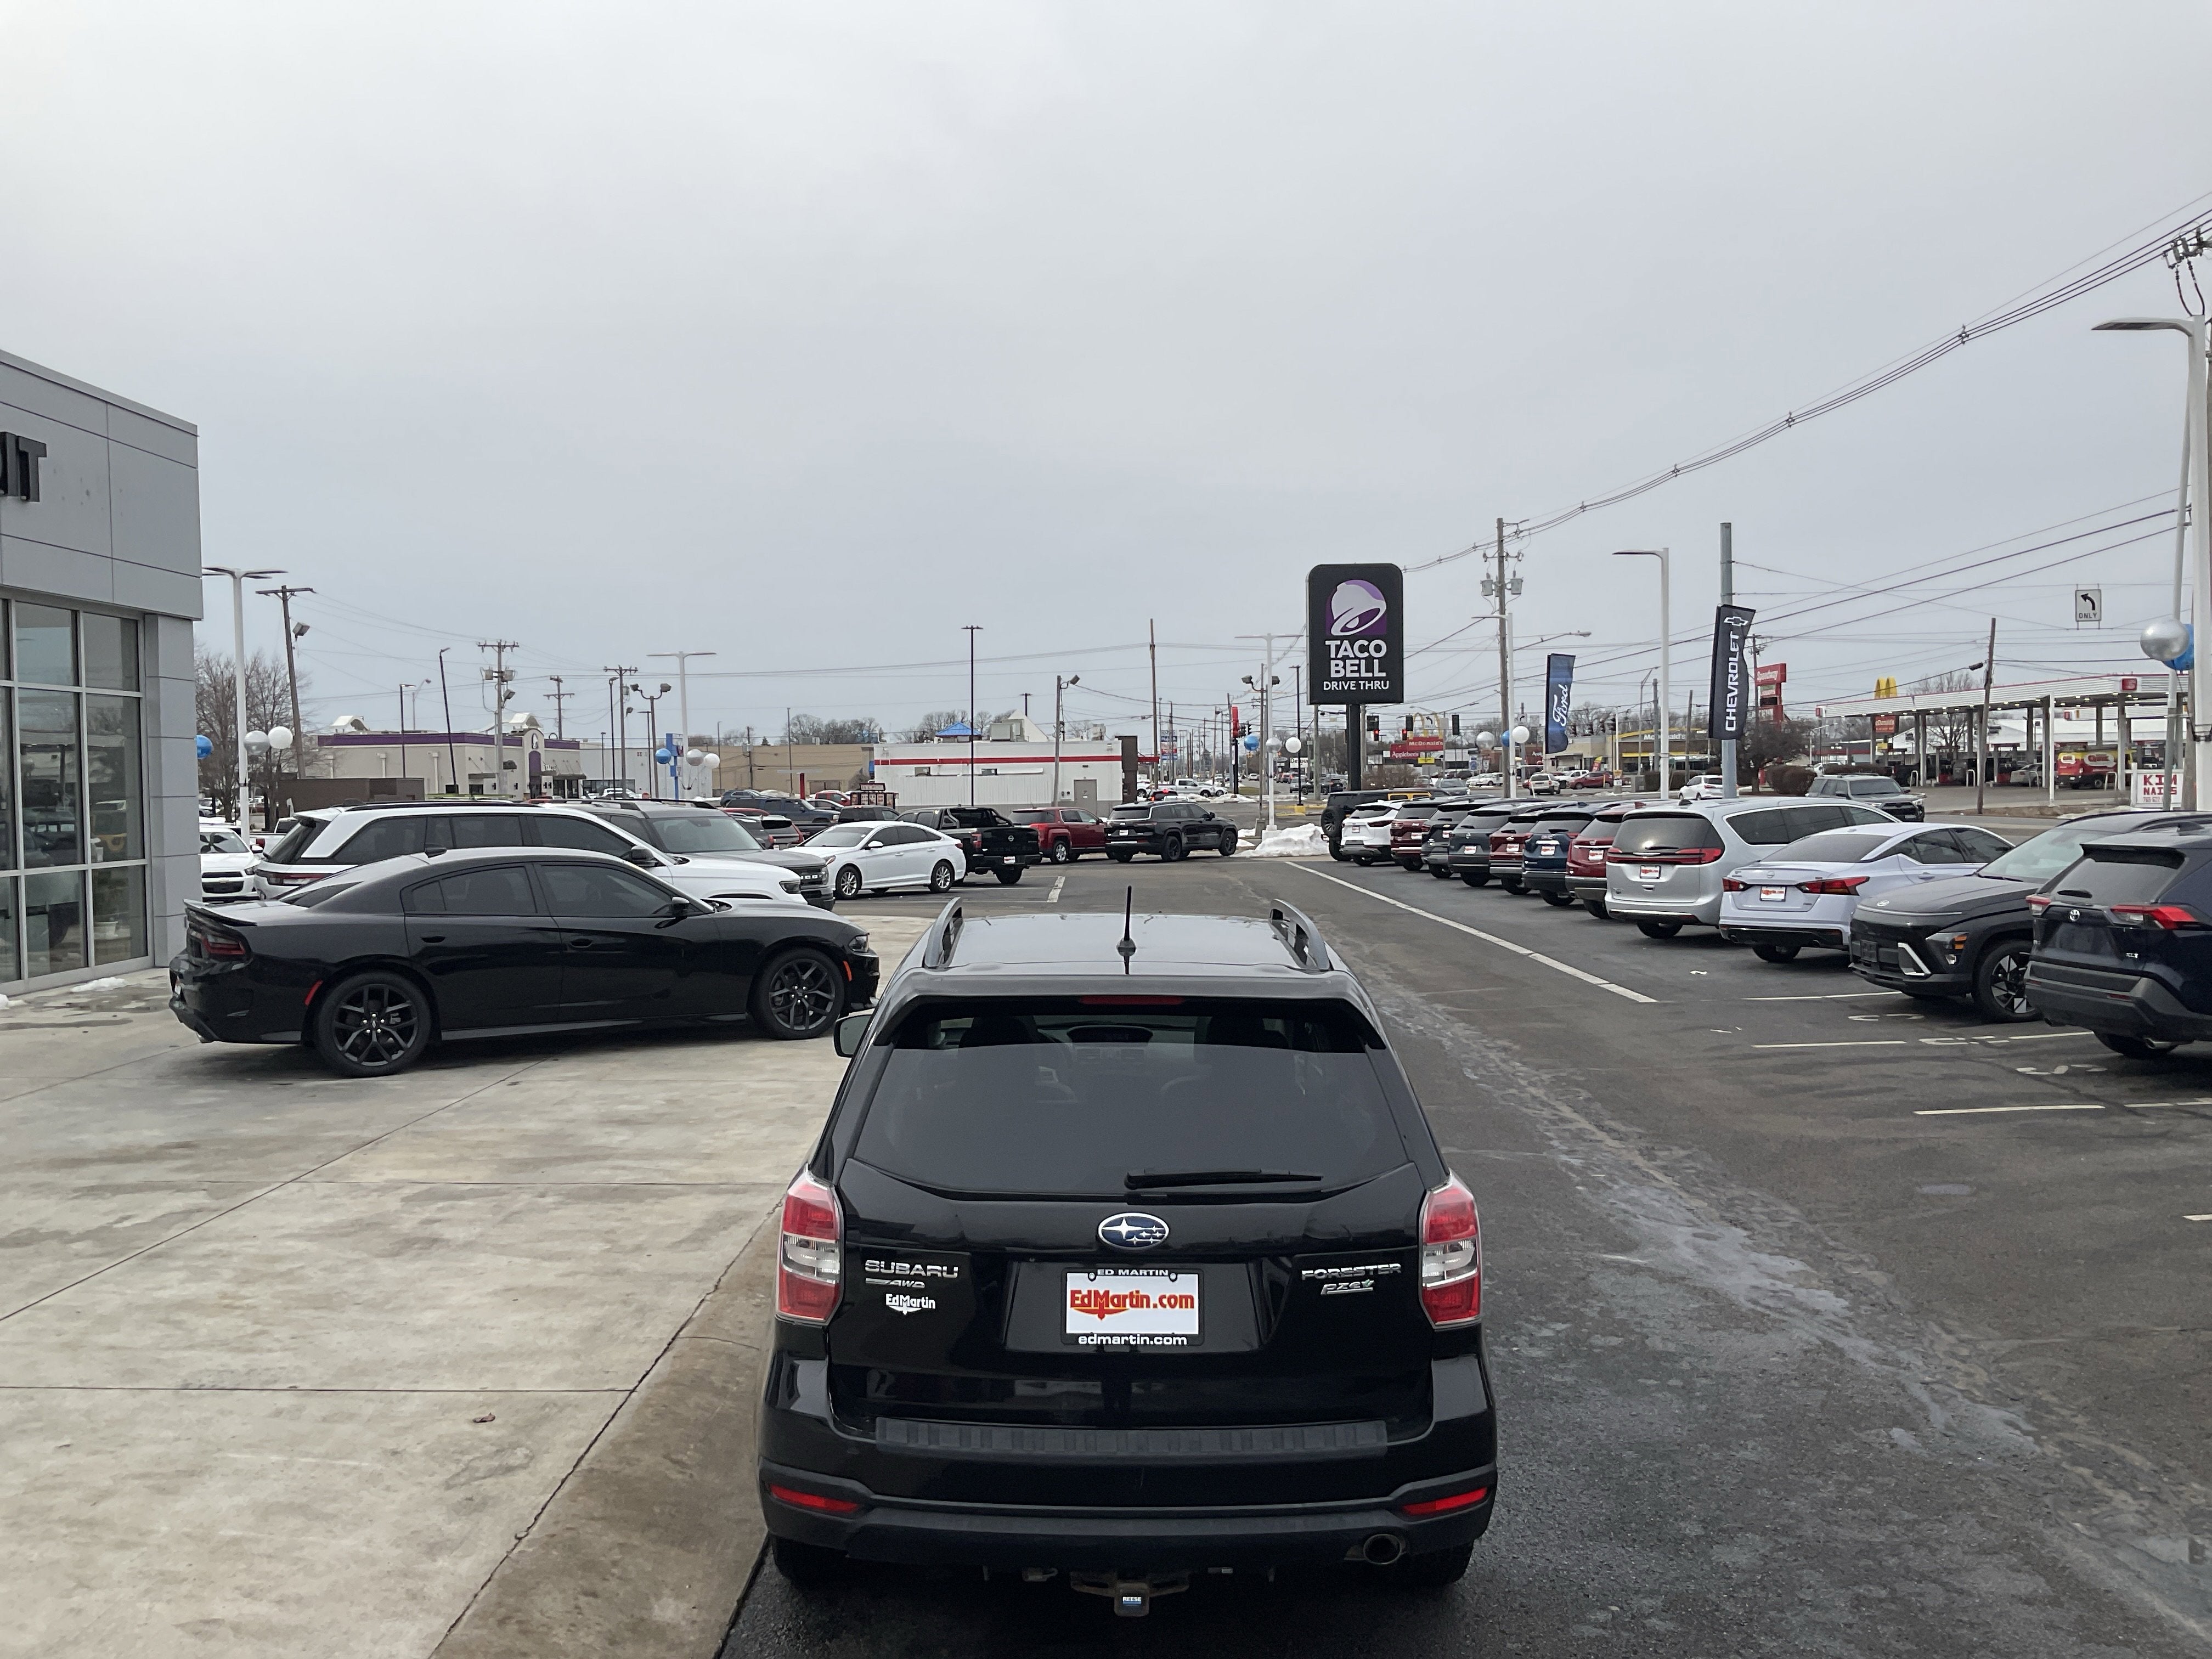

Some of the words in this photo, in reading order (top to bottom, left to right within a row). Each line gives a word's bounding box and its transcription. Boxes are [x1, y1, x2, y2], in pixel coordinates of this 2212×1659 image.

[1325, 639, 1387, 658] TACO
[1330, 659, 1386, 678] BELL
[1323, 681, 1356, 690] DRIVE
[1359, 680, 1390, 690] THRU
[1725, 630, 1739, 731] CHEVROLET
[1553, 684, 1568, 726] Ford
[2143, 787, 2177, 795] NAIS
[865, 1260, 958, 1278] SUBARU
[1301, 1263, 1402, 1281] FORESTER
[888, 1279, 926, 1288] AWD
[1070, 1290, 1194, 1309] EdMartin.com
[1078, 1334, 1187, 1345] edmartin.com
